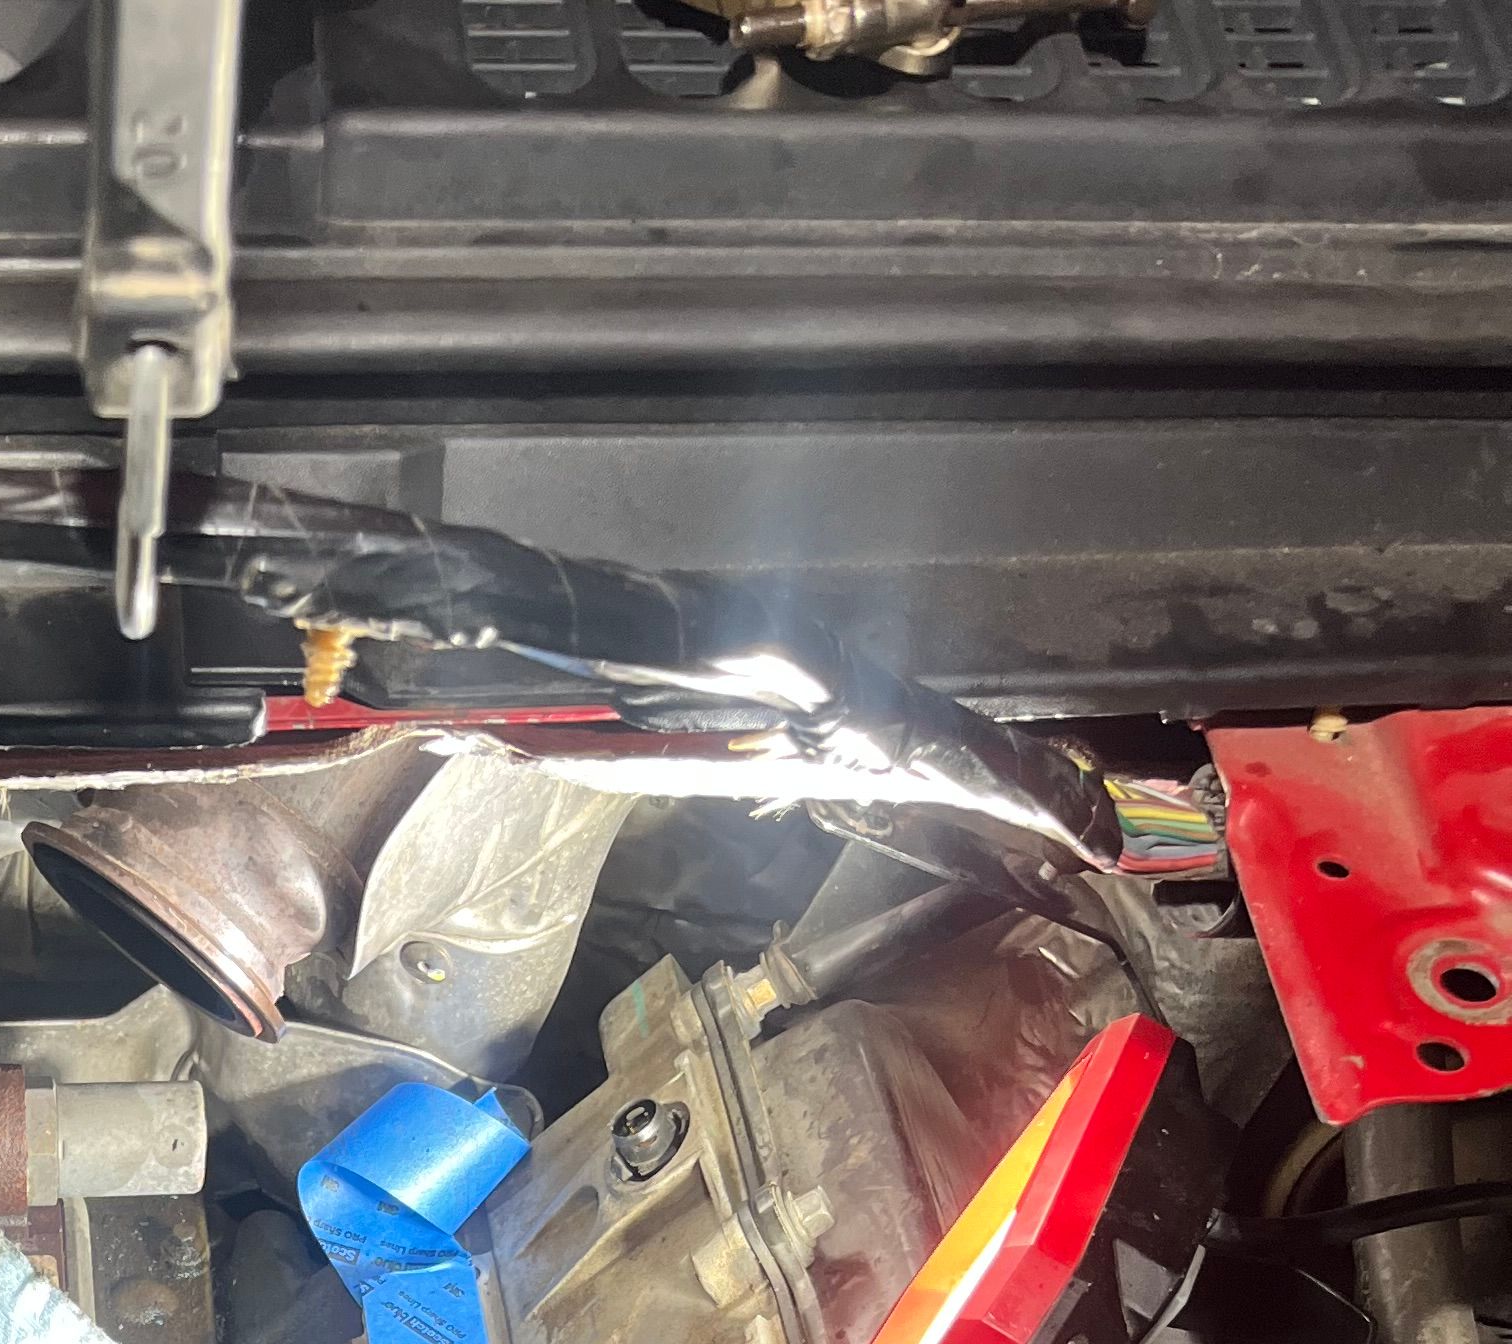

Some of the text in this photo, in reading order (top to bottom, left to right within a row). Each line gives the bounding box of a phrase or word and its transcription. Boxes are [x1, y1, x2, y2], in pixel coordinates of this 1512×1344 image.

[313, 1219, 365, 1243] PRO Sharp
[379, 1242, 405, 1252] Lines
[408, 1247, 435, 1257] Sharp
[443, 1281, 464, 1298] 3M
[382, 1300, 409, 1324] blue
[397, 1290, 465, 1339] PRO Sharp Lines
